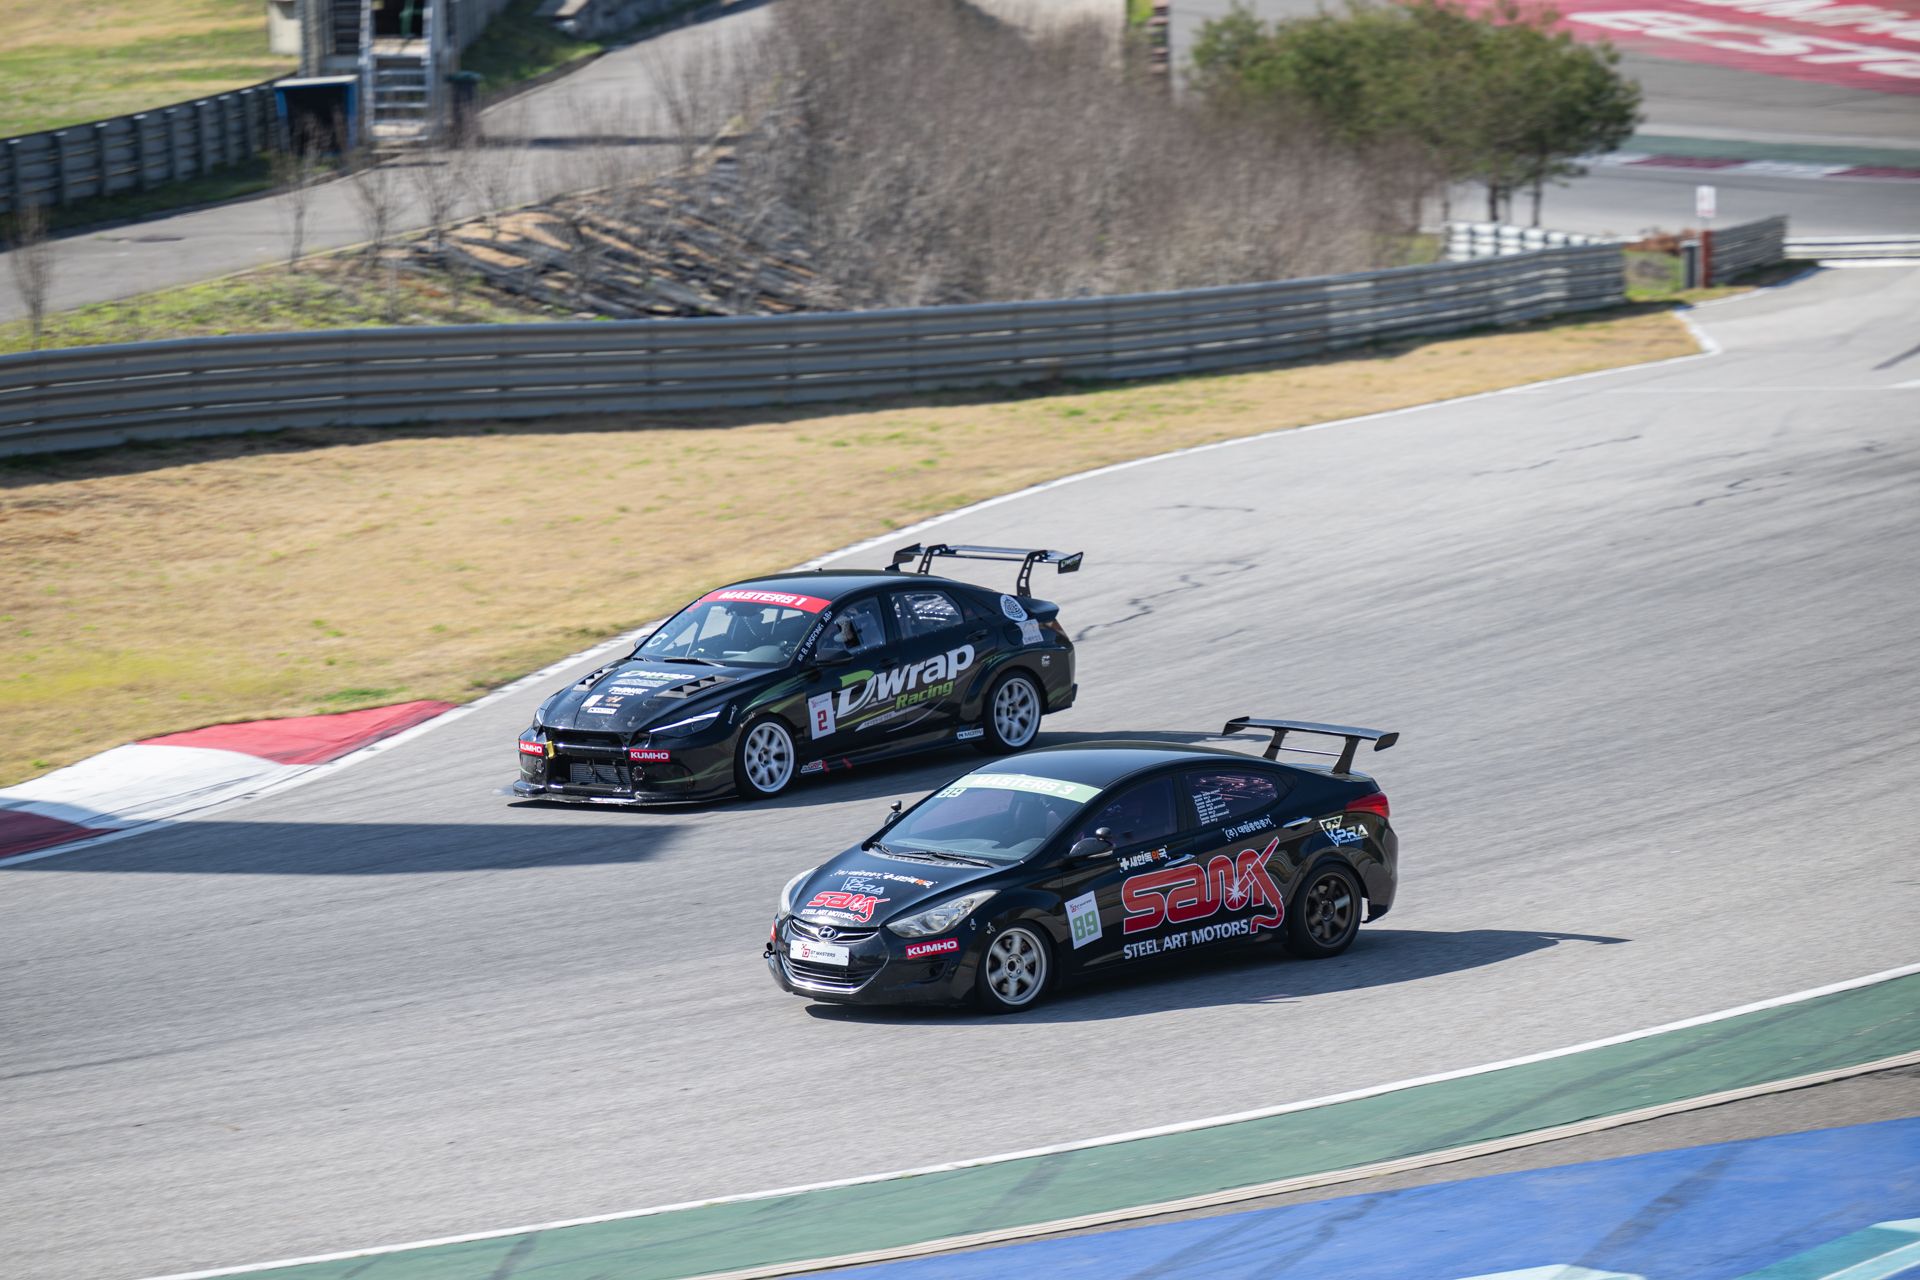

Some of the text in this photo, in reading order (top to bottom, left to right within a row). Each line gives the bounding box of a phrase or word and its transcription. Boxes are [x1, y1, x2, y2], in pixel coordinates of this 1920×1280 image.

[719, 592, 808, 606] MASTERS 1
[895, 681, 954, 709] Racing
[817, 709, 828, 732] 2
[520, 743, 543, 753] KUMHO
[630, 751, 669, 760] KUMHO
[971, 776, 1077, 795] MASTERS 3
[828, 910, 856, 921] MOTORS
[1072, 910, 1099, 942] 89
[907, 940, 959, 956] KUMHO
[1124, 919, 1249, 960] STEEL ART MOTORS
